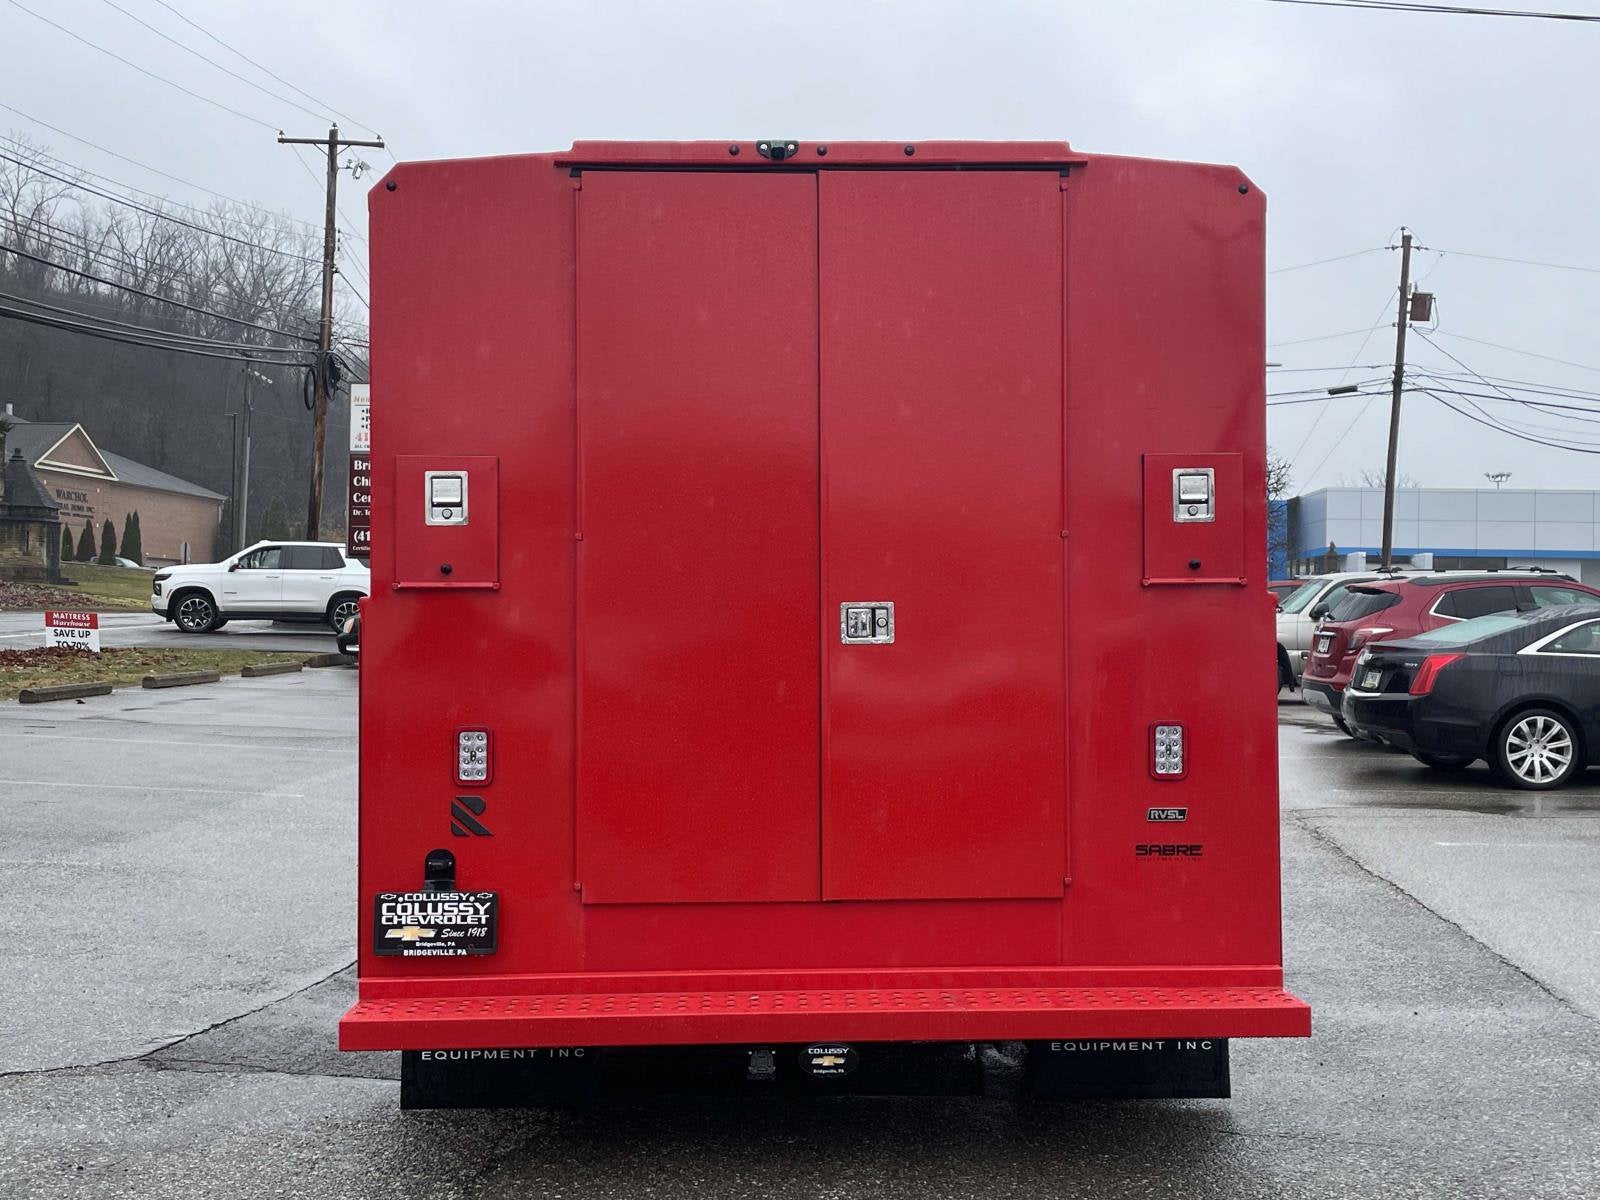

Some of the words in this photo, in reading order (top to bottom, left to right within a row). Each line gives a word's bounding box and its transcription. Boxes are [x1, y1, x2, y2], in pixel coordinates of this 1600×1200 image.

[52, 612, 91, 621] MATTRESS
[52, 619, 91, 627] Warehouse
[53, 629, 76, 638] SAVE
[78, 630, 91, 639] UP
[1150, 810, 1184, 820] RVSL
[1135, 844, 1203, 857] SABRE
[404, 892, 469, 901] COLUSSY
[381, 902, 491, 916] COLUSSY
[381, 915, 489, 925] CHEVROLET
[440, 928, 465, 938] Since
[467, 927, 488, 938] 1918
[1051, 1041, 1165, 1051] EQUIPMENT
[1177, 1041, 1213, 1050] INC
[421, 1049, 537, 1061] EQUIPMENT
[549, 1048, 585, 1058] INC
